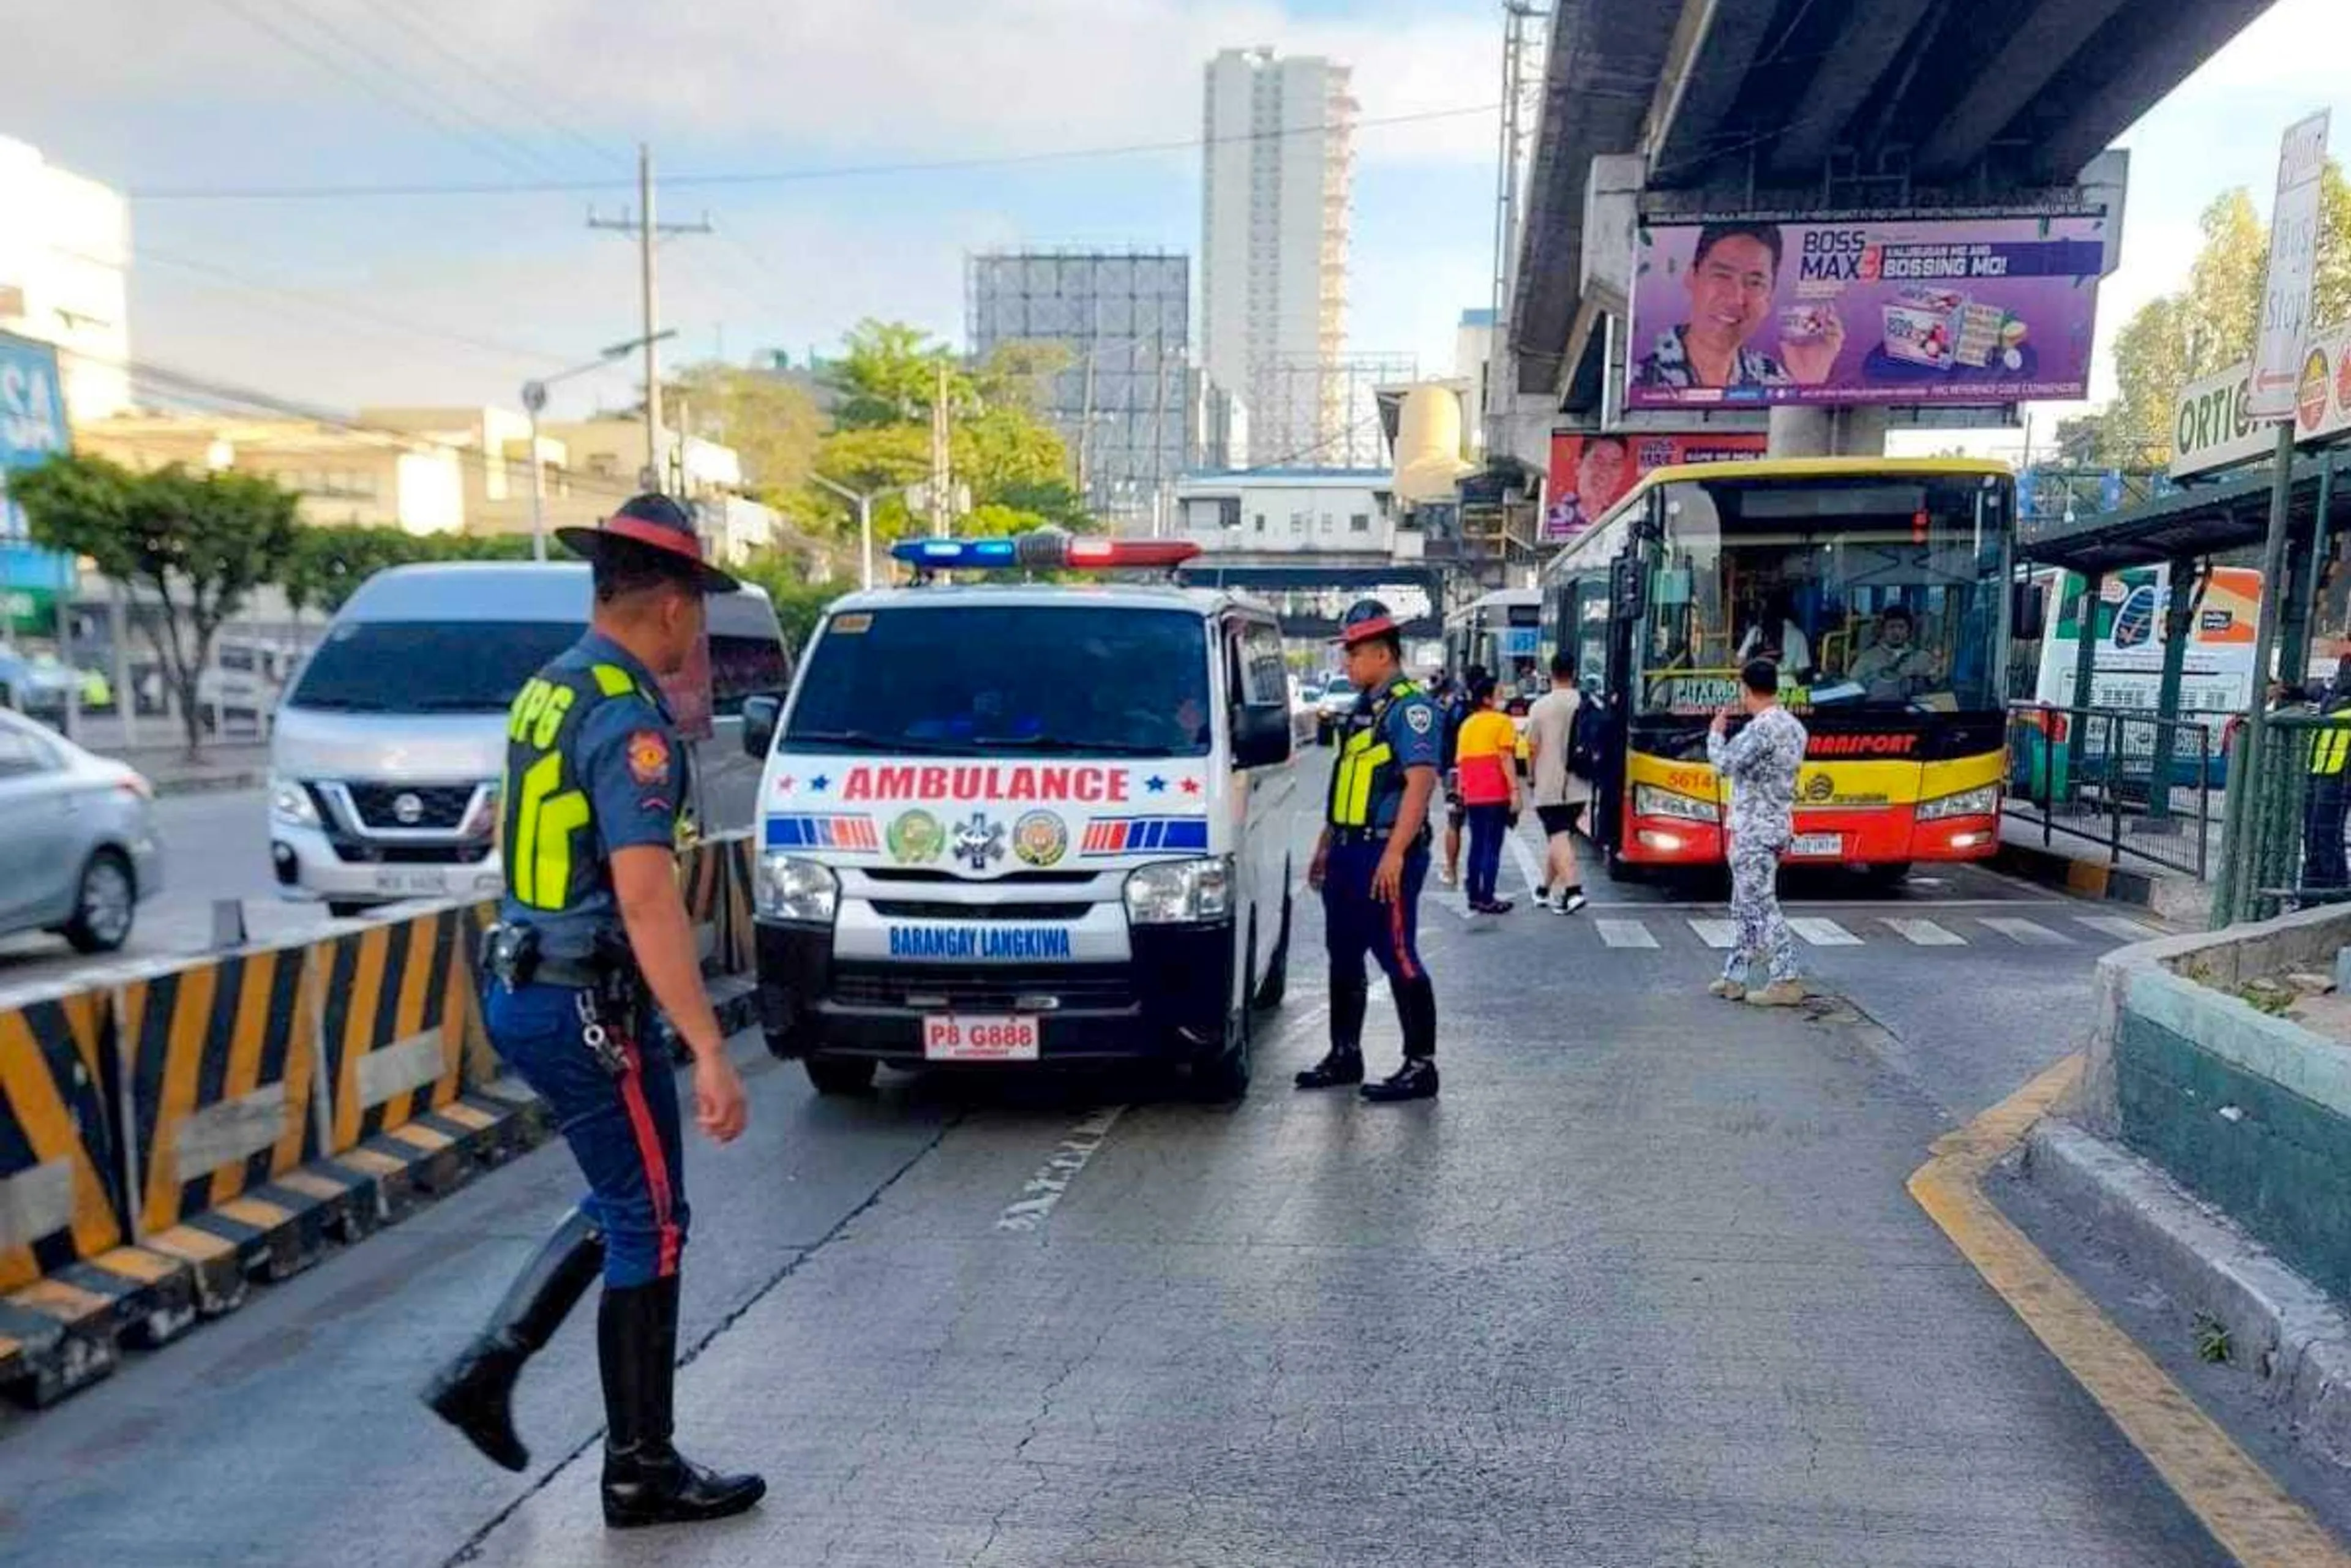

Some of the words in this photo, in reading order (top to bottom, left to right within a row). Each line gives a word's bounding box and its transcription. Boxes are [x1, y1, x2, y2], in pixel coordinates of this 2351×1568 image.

[1803, 230, 1865, 253] BOSS
[1799, 255, 1862, 281] MAX
[1883, 258, 1967, 277] BOSSING
[1971, 256, 2008, 276] MO!
[2178, 377, 2281, 454] ORTIG
[1808, 734, 1918, 754] RANSPORT
[844, 767, 1130, 801] AMBULANCE
[890, 926, 976, 956] BARANGAY
[981, 927, 1070, 956] LANGKIWA
[970, 1024, 1032, 1046] G888
